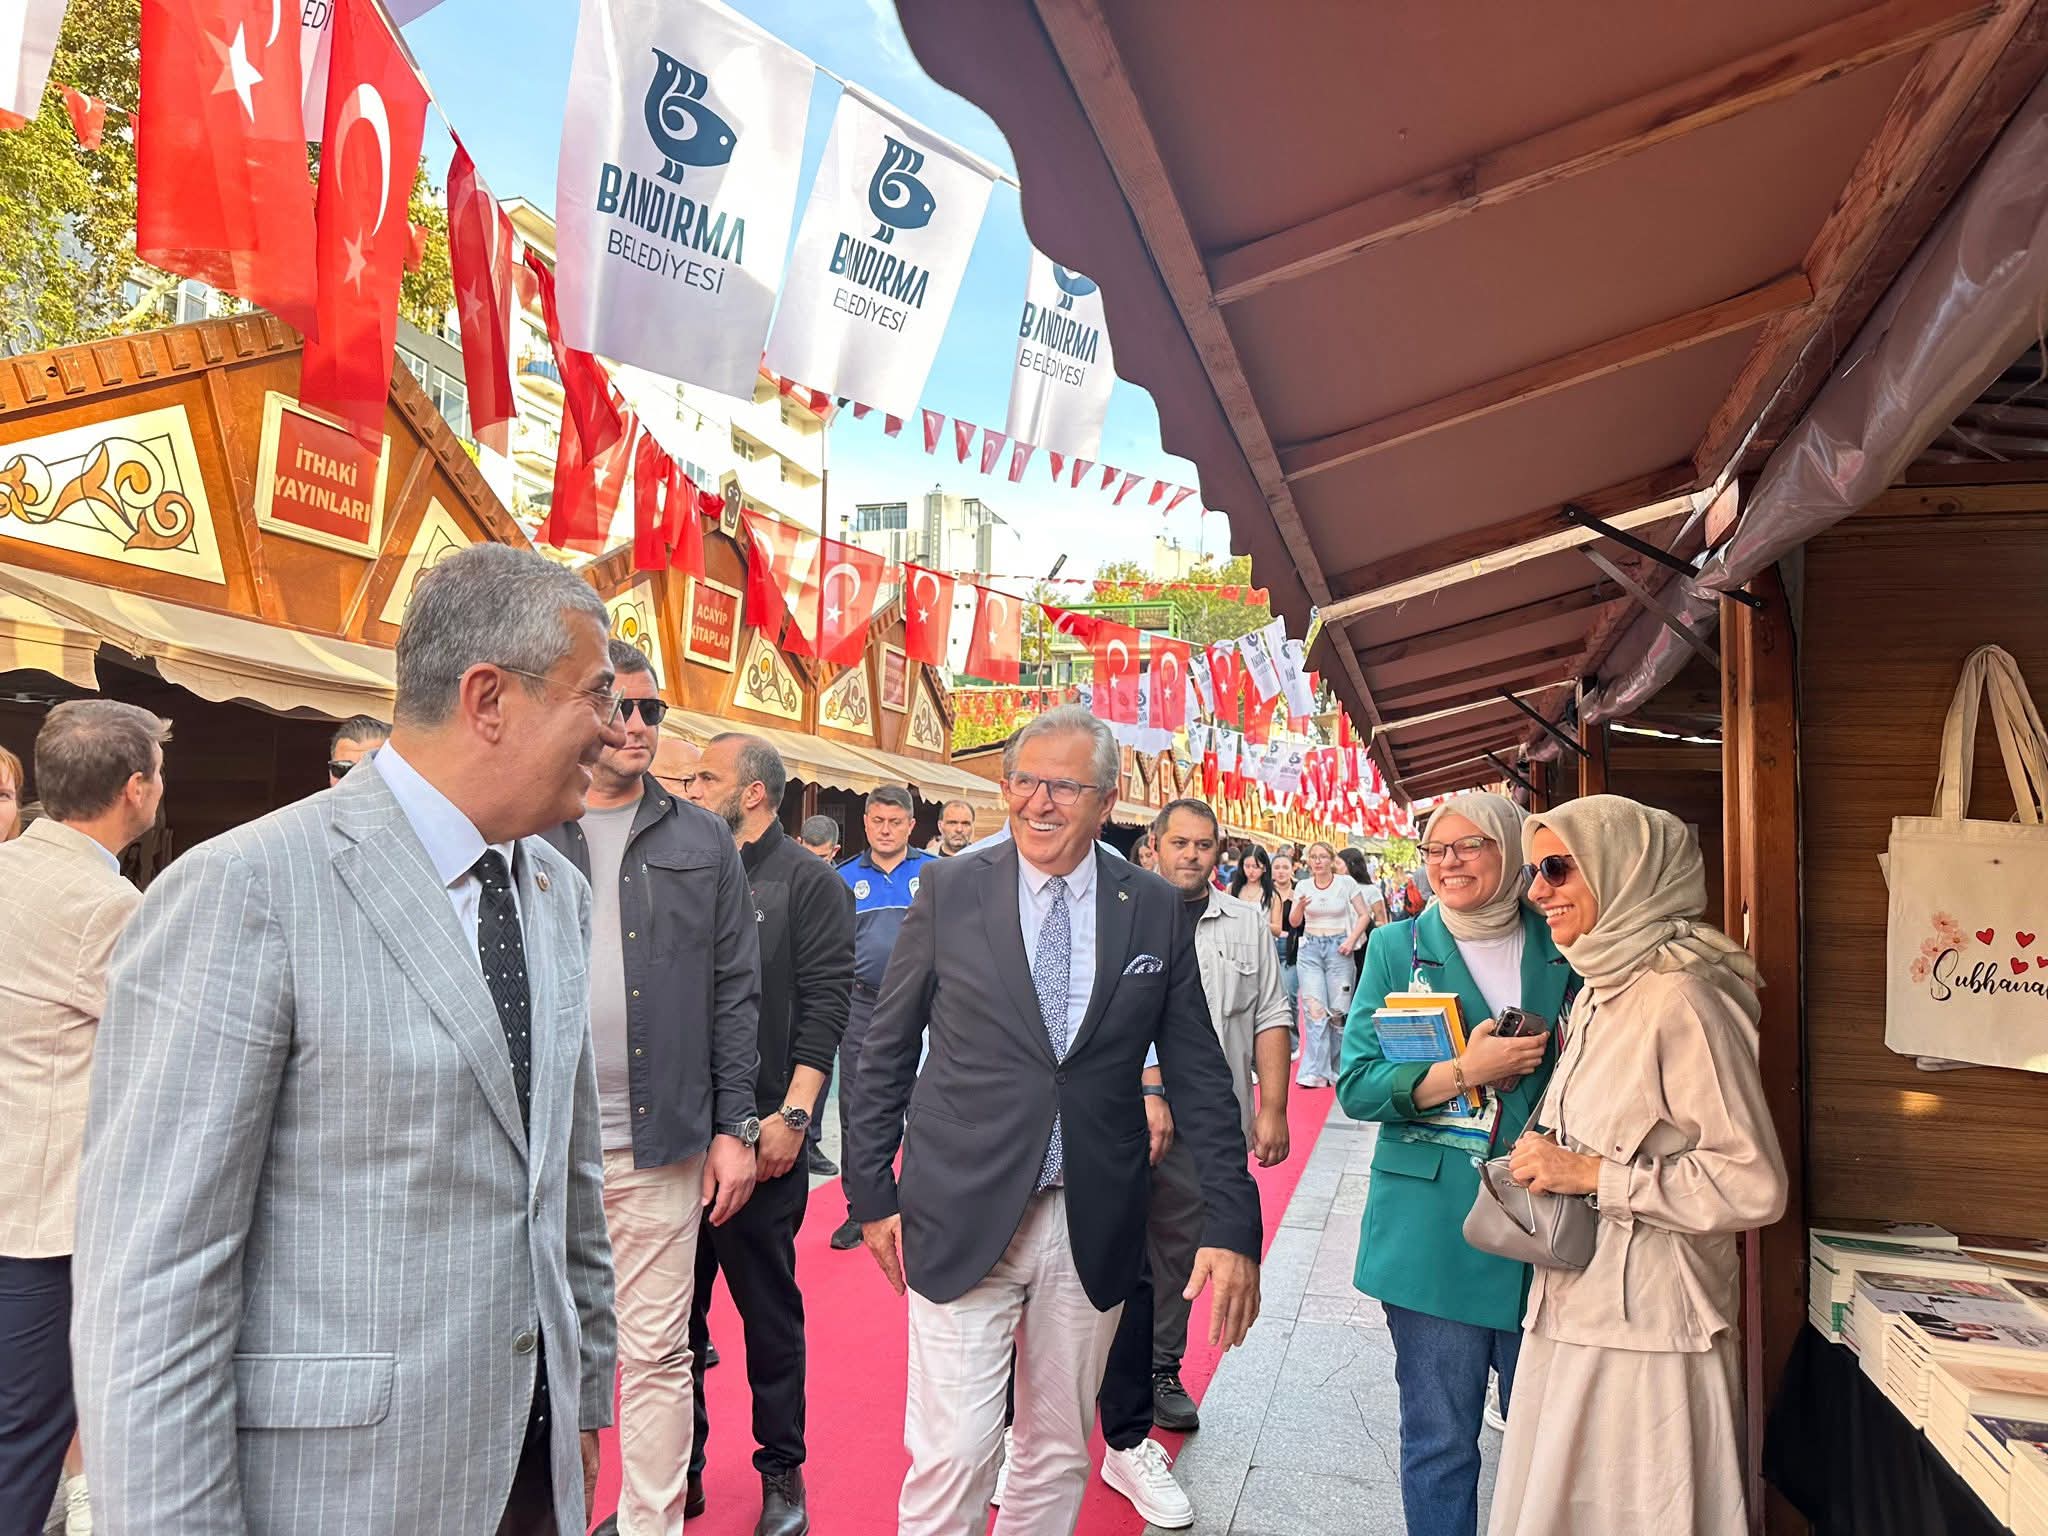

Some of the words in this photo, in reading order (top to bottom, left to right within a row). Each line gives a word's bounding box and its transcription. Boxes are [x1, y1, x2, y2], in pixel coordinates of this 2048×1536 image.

[596, 162, 746, 265] BANDIRMA
[607, 228, 726, 294] BELEDİYESİ
[1019, 300, 1099, 365] BANDIRMA
[1020, 348, 1086, 387] BELEDİYESİ
[295, 442, 358, 488] İTHAKİ
[273, 473, 371, 524] YAYINLARI
